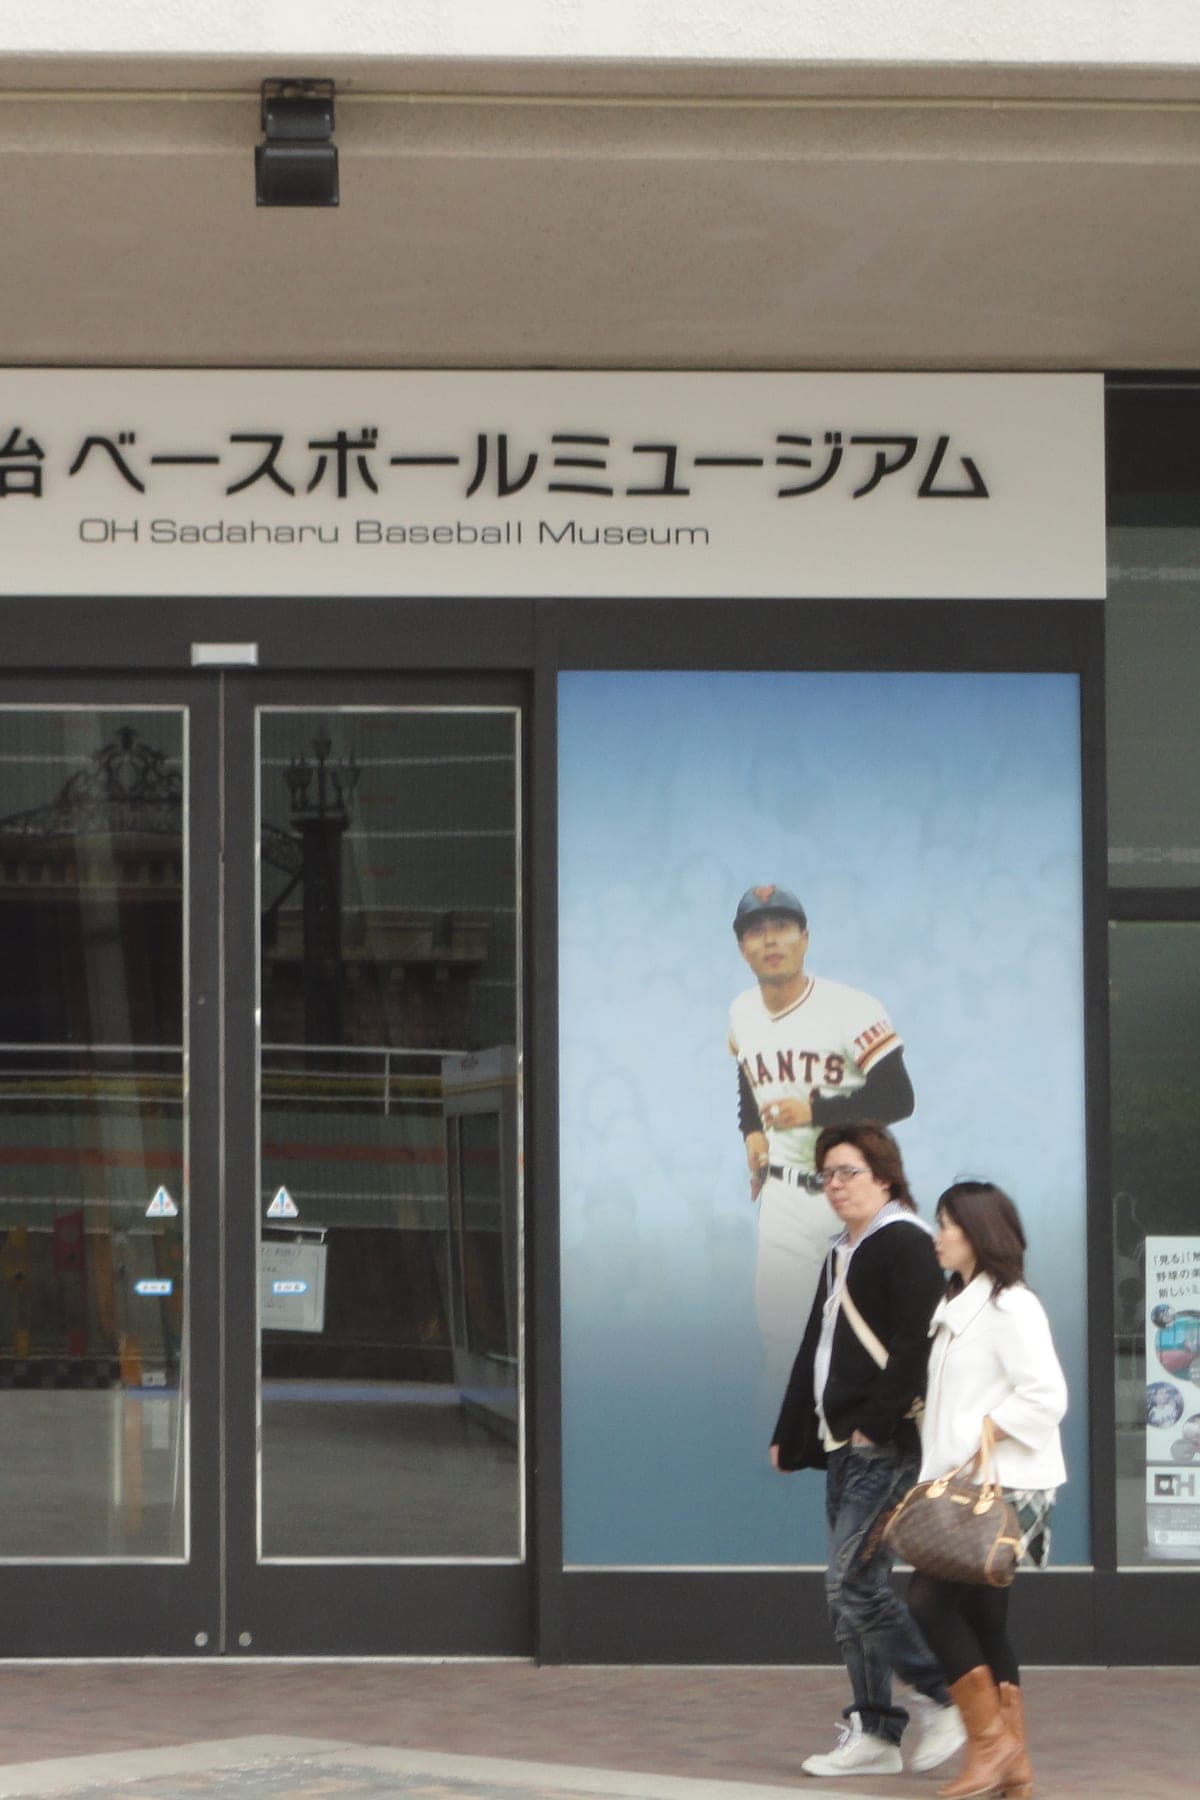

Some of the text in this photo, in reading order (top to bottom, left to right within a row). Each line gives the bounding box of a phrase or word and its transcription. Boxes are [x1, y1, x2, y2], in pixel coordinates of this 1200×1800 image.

[78, 518, 711, 546] OH Sadaharu Baseball Museum
